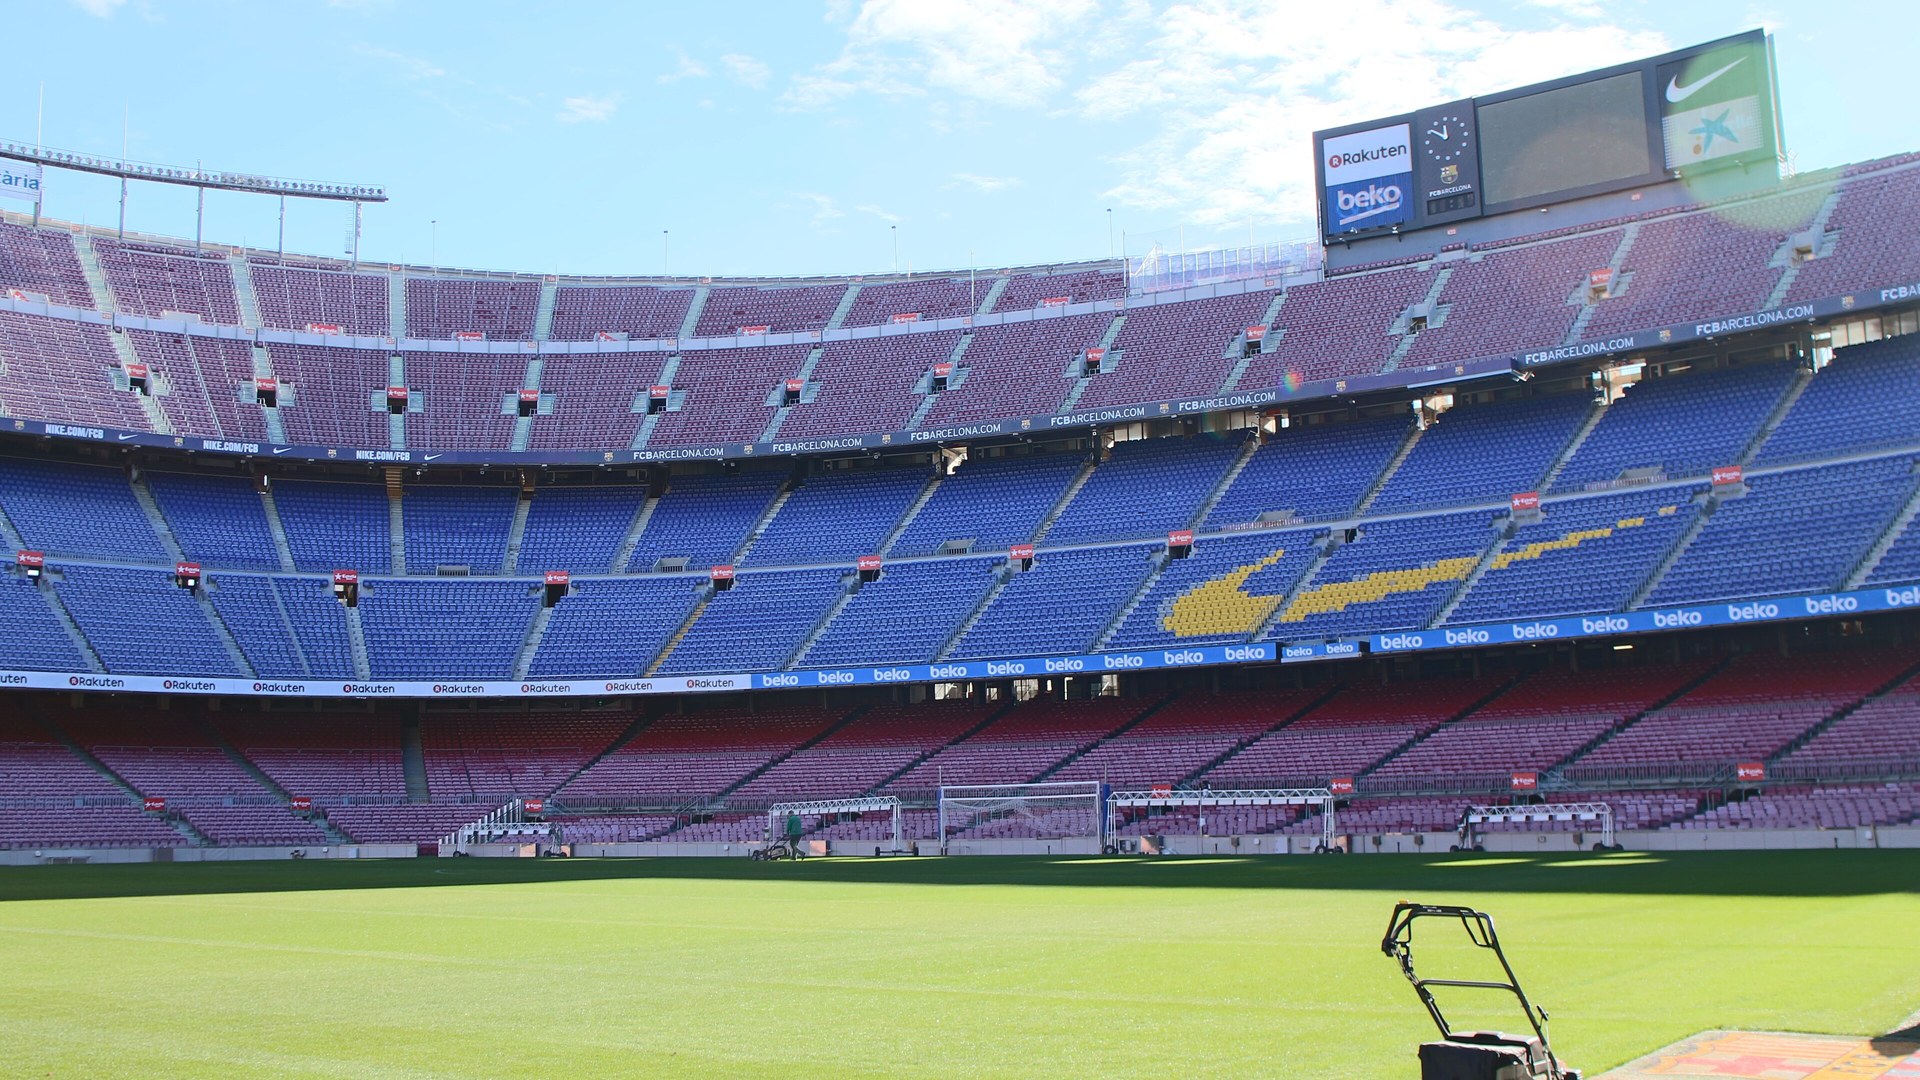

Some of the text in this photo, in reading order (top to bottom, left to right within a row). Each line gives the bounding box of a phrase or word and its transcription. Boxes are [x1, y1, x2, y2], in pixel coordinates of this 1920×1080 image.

[1343, 143, 1407, 165] Rakuten
[0, 171, 39, 190] ària
[1337, 184, 1400, 211] beko
[1429, 184, 1472, 198] FCBARCELONA
[1696, 305, 1814, 335] FCBARCELONA.COM
[1525, 337, 1634, 365] FCBARCELONA.COM
[1179, 392, 1276, 411] FCBARCELONA.COM
[1051, 407, 1145, 426] FCBARCELONA.COM
[45, 424, 104, 439] NIKE.COM/FCB
[910, 424, 1000, 441] FCBARCELONA.COM
[203, 440, 258, 453] NIKE.COM/FCB
[773, 438, 862, 452] FCBARCELONA.COM
[356, 450, 410, 461] NIKE.COM/FCB
[633, 448, 724, 460] FCBARCELONA.COM
[1806, 595, 1857, 613] beko
[1728, 602, 1778, 620] beko
[1582, 616, 1629, 633] beko
[1654, 610, 1702, 627] beko
[1446, 629, 1489, 644] beko
[1513, 623, 1557, 639] beko
[1381, 634, 1422, 649] beko
[1225, 647, 1265, 660] beko
[1286, 647, 1312, 657] beko
[1326, 643, 1354, 654] beko
[1045, 658, 1083, 671] beko
[1104, 655, 1143, 668] beko
[1164, 651, 1203, 665] beko
[930, 665, 967, 678] beko
[987, 661, 1025, 674] beko
[763, 674, 798, 686] beko
[818, 671, 854, 683] beko
[874, 668, 910, 681] beko
[79, 677, 124, 687] Rakuten
[171, 681, 215, 690] Rakuten
[262, 683, 305, 693] Rakuten
[352, 684, 395, 693] Rakuten
[441, 684, 484, 693] Rakuten
[529, 684, 570, 693] Rakuten
[612, 682, 652, 691] Rakuten
[694, 679, 734, 688] Rakuten
